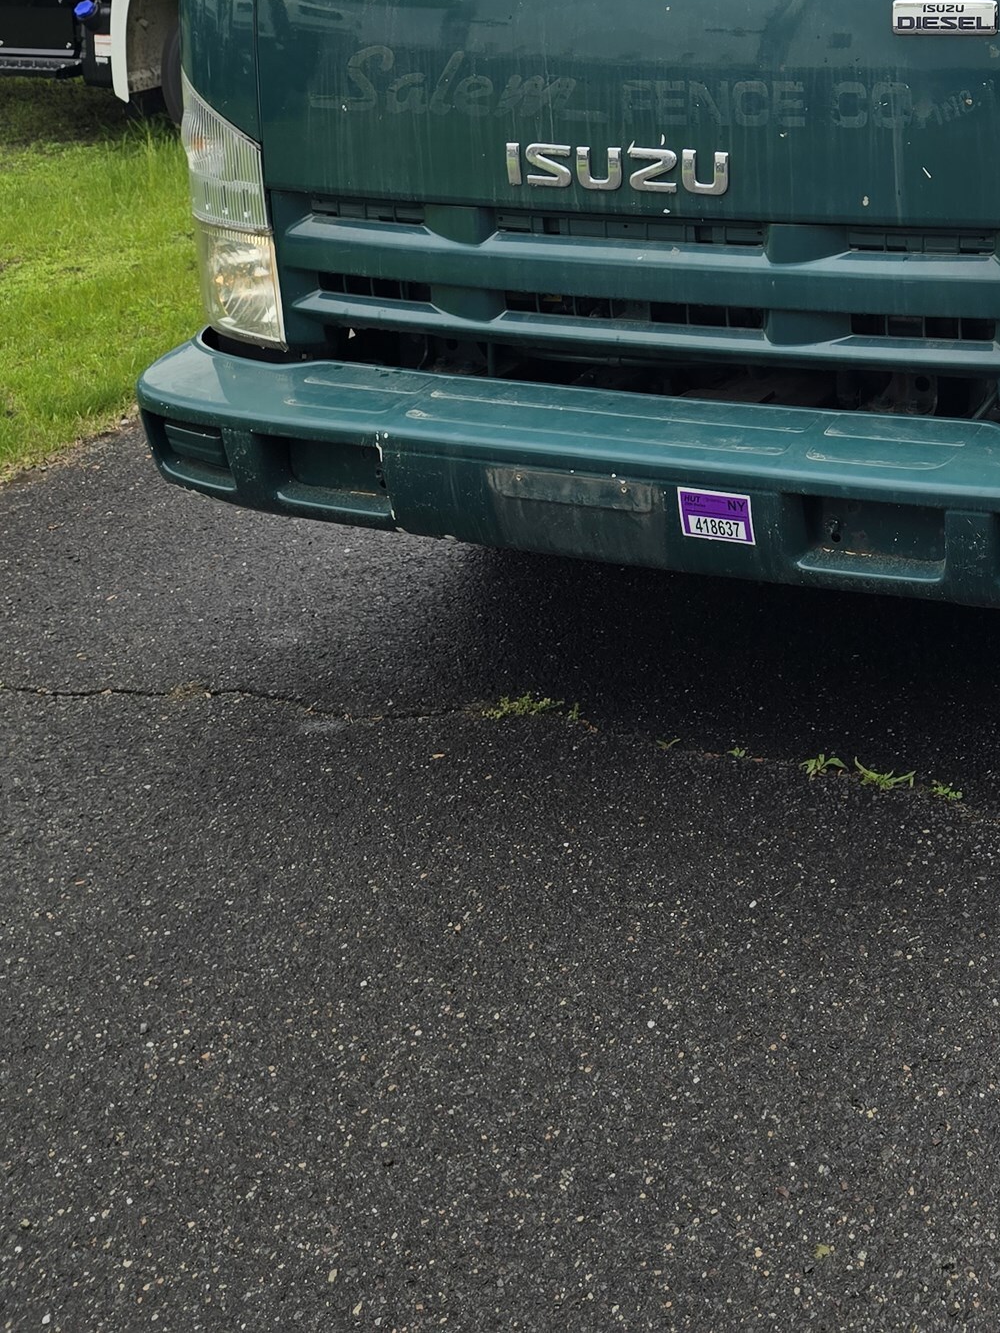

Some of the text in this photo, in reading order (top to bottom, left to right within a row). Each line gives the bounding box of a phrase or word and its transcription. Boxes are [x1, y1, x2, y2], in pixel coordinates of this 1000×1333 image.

[922, 4, 965, 13] ISUZU
[897, 16, 991, 30] DIESEL
[309, 44, 609, 123] Salem
[622, 79, 806, 127] FENCE
[505, 141, 730, 196] ISUZU
[684, 494, 701, 503] HUT
[727, 500, 746, 512] NY
[695, 517, 740, 538] 418637
